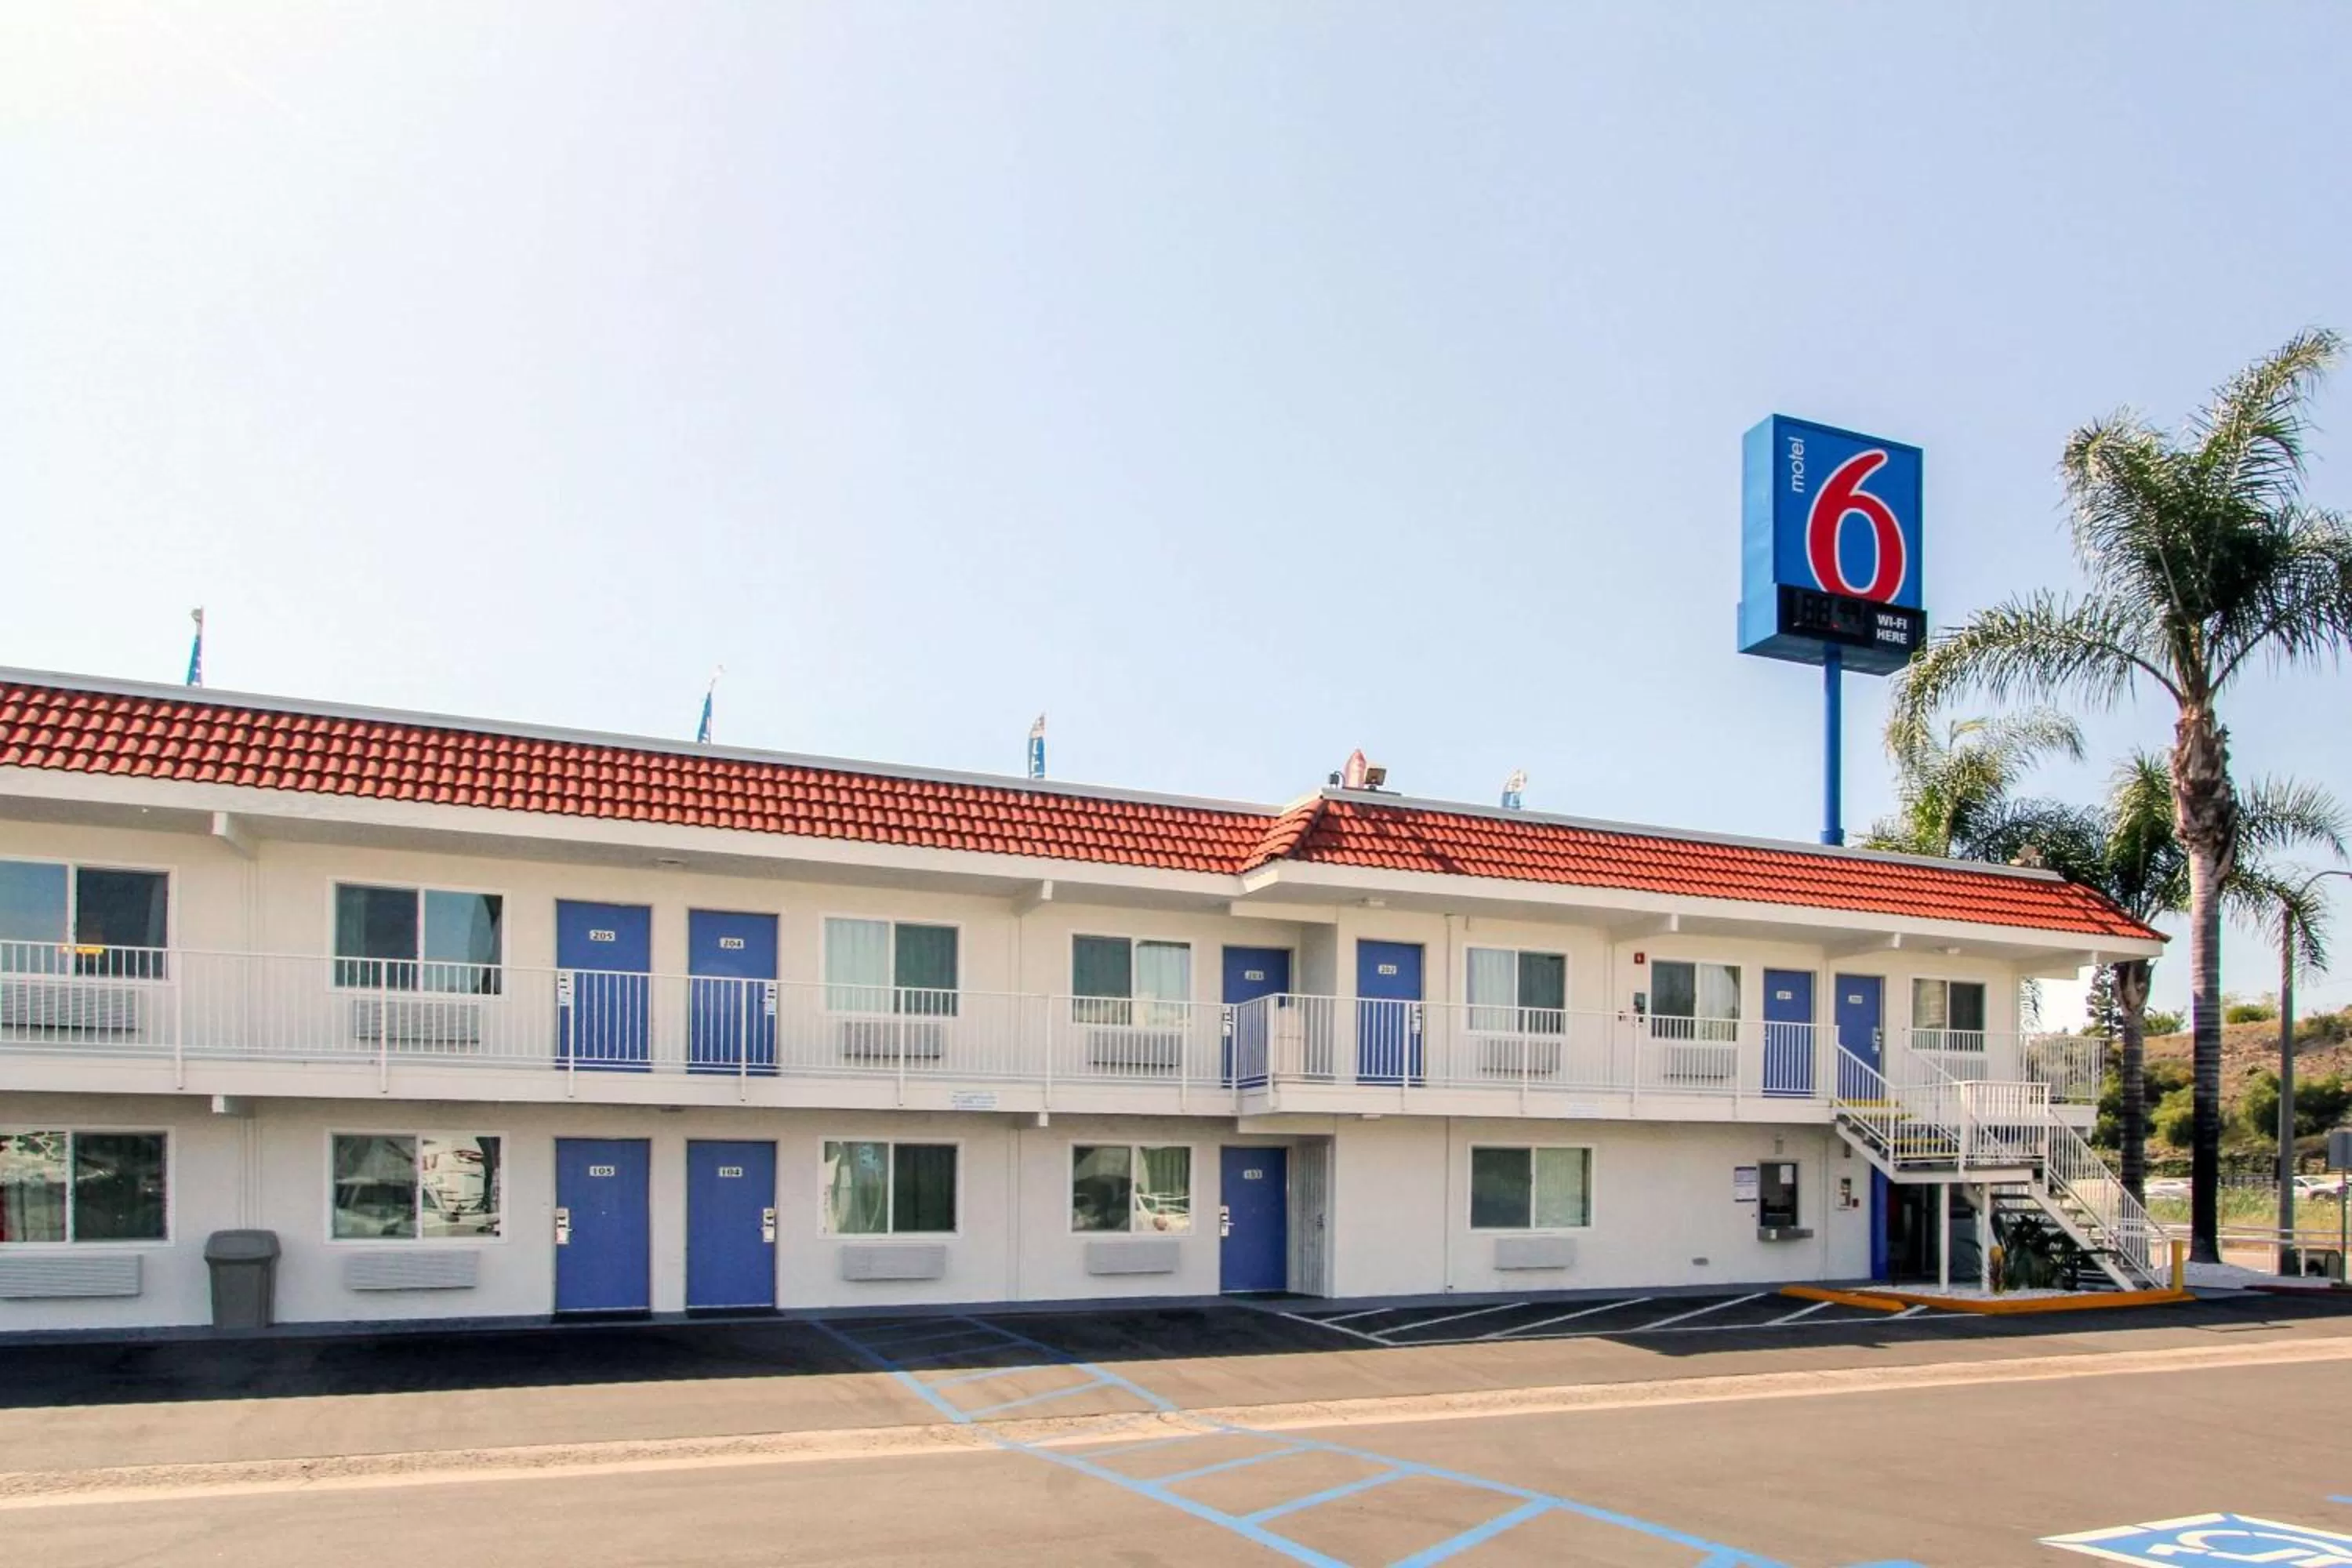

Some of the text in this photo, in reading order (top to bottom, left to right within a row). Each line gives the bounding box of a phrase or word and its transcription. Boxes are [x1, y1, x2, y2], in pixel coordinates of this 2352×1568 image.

[1788, 437, 1805, 493] motel
[1806, 448, 1907, 604] 6
[1876, 614, 1907, 630] WI-FI
[1876, 630, 1907, 644] HERE
[593, 931, 613, 940] 205
[593, 1167, 612, 1175] 105
